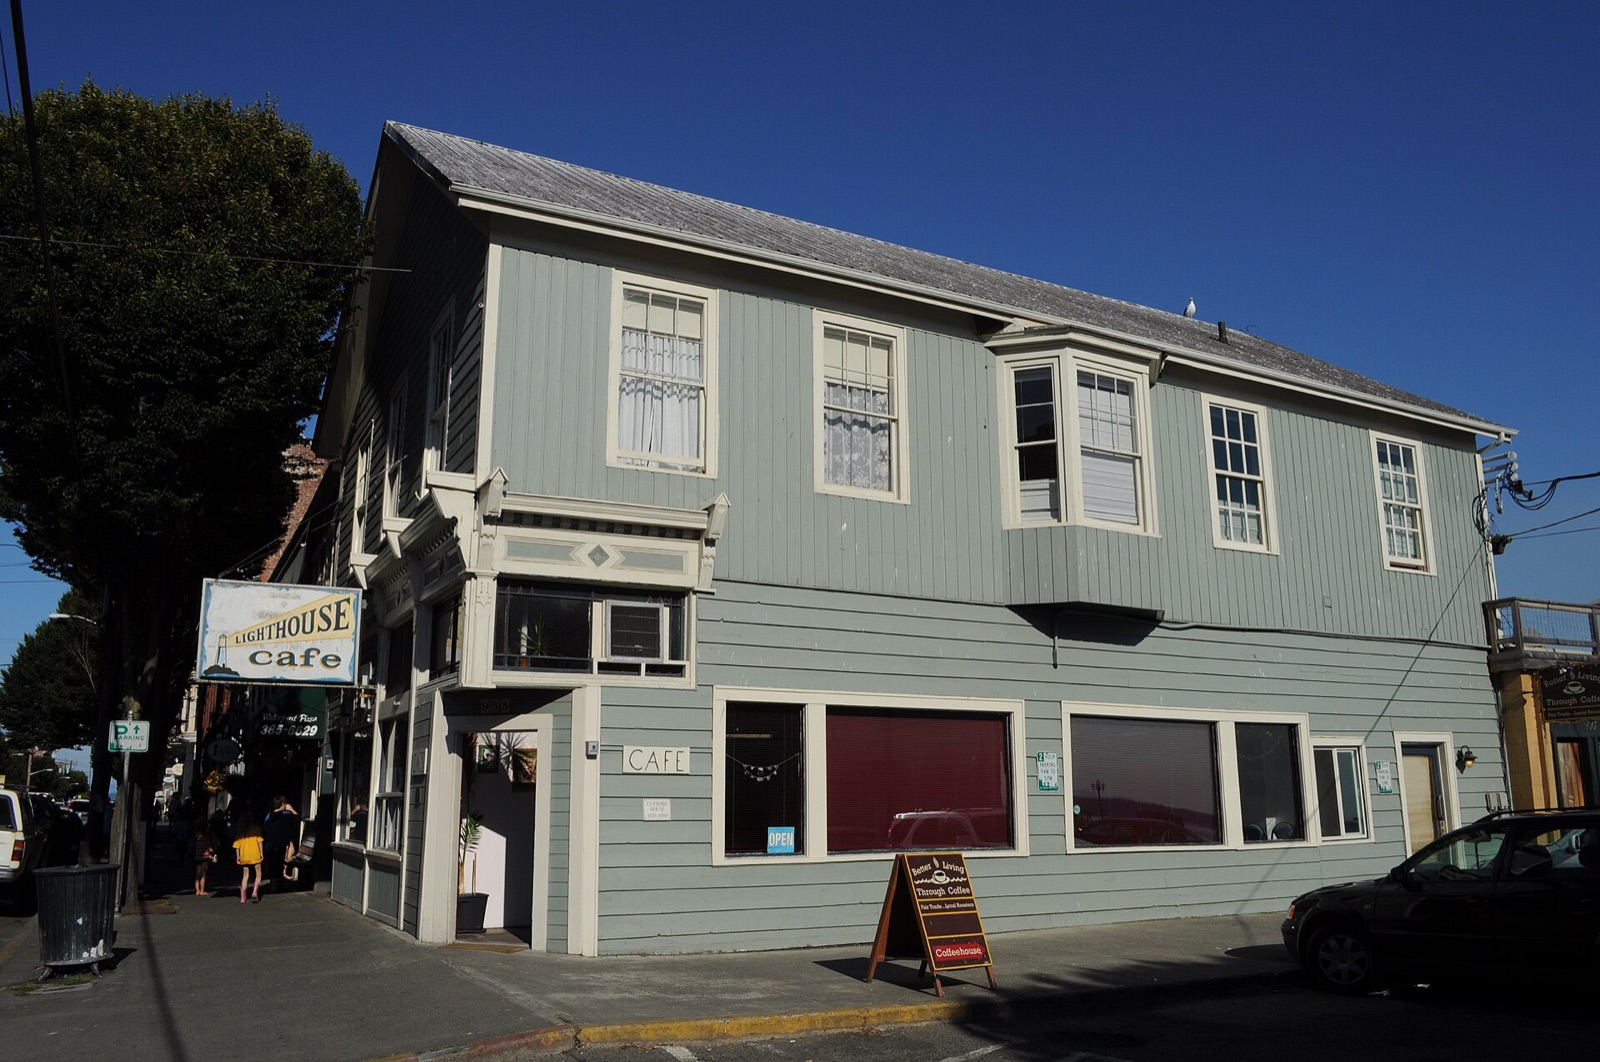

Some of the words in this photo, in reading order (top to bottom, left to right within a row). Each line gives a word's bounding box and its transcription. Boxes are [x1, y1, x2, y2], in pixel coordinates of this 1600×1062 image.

[234, 597, 351, 645] LIGHTHOUSE
[248, 647, 342, 670] cafe
[1543, 674, 1567, 688] Better
[482, 701, 508, 711] 955
[1546, 697, 1577, 706] Through
[260, 724, 318, 737] 385-6629
[628, 748, 685, 772] CAFE
[770, 832, 793, 846] OPEN
[911, 863, 931, 876] Better
[942, 861, 964, 874] Living
[916, 888, 946, 897] Through
[947, 886, 970, 895] Coffee
[935, 946, 982, 958] Coffeehouse
